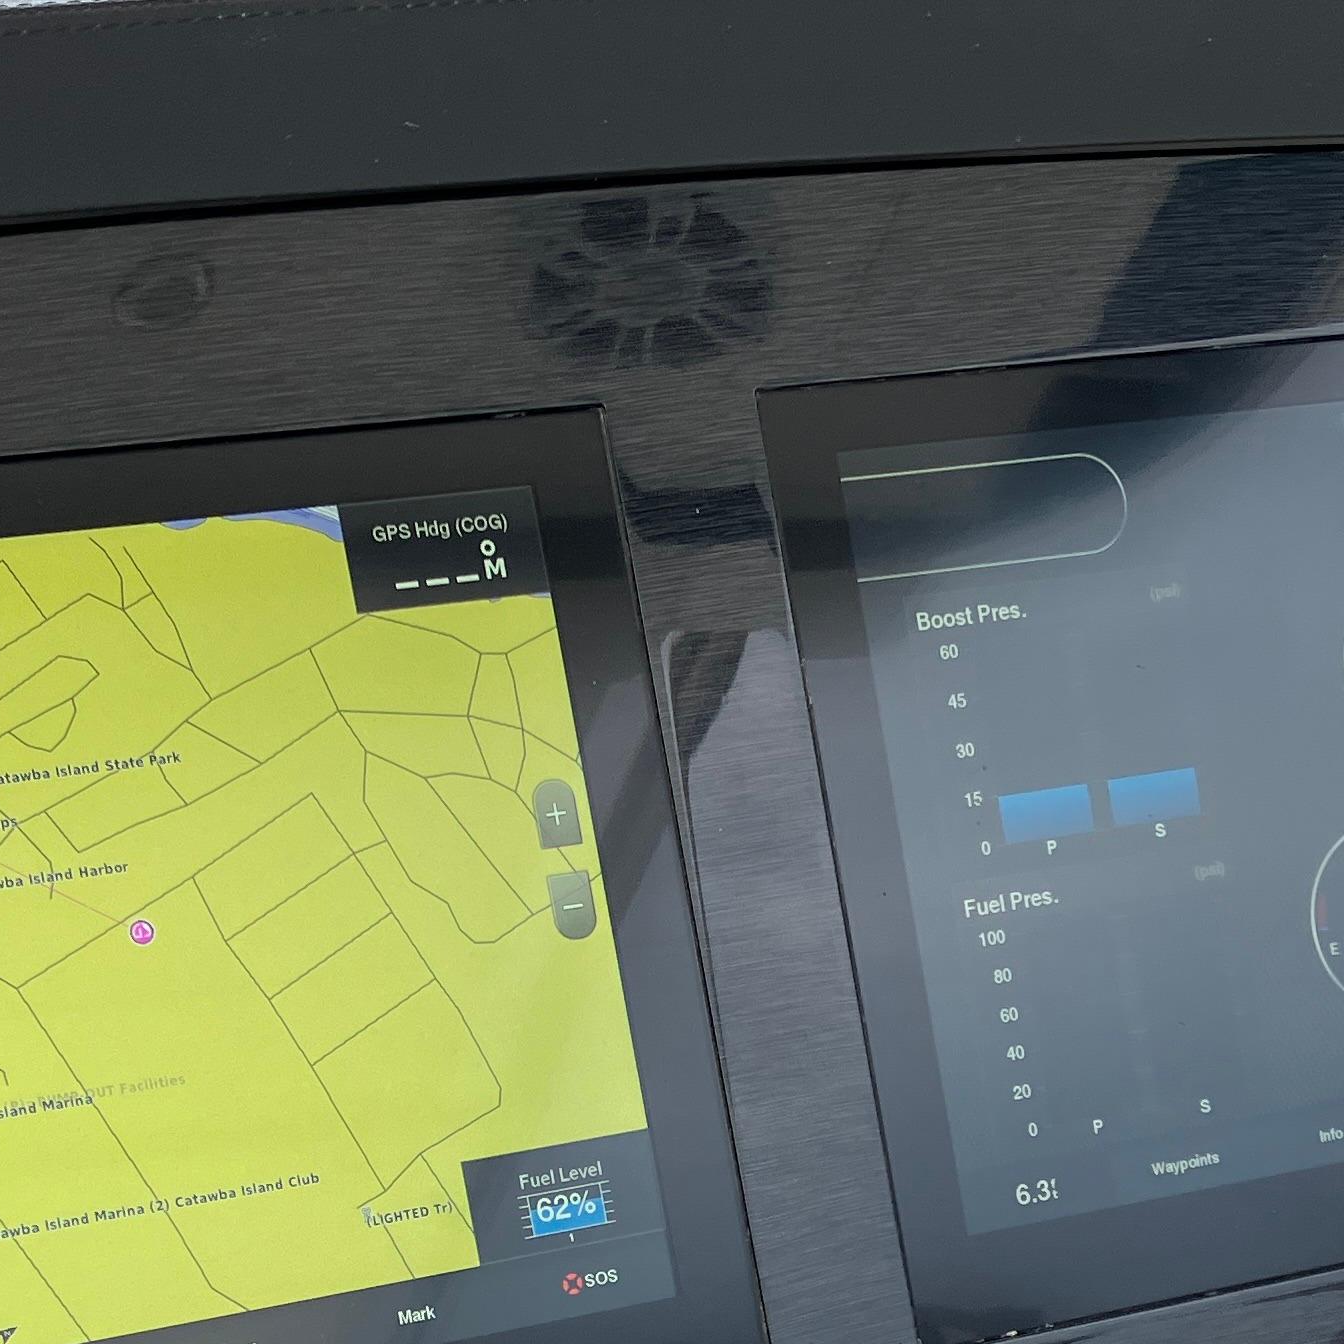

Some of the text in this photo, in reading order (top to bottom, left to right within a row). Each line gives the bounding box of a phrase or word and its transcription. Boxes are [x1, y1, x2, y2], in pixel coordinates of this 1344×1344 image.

[372, 513, 509, 543] GPS Hdg (COG)
[916, 603, 1027, 631] Boost Pres.
[56, 758, 99, 777] Island
[105, 756, 144, 774] State
[150, 751, 181, 767] Park
[29, 868, 73, 886] Island
[79, 862, 129, 879] Harbor
[964, 890, 1059, 918] Fuel Pres.
[978, 930, 1006, 947] 100
[42, 1094, 93, 1112] Marina
[1013, 1084, 1032, 1100] 20
[1319, 1128, 1344, 1143] Info
[518, 1160, 603, 1190] Fuel Level
[1152, 1151, 1220, 1176] Waypoints
[45, 1211, 90, 1233] Island
[95, 1203, 145, 1226] Marina
[149, 1198, 170, 1214] (2)
[175, 1187, 237, 1209] Catawba
[240, 1178, 284, 1199] Island
[288, 1172, 320, 1187] Club
[535, 1190, 597, 1223] 62%
[585, 1269, 619, 1288] SOS
[397, 1305, 436, 1326] Mark
